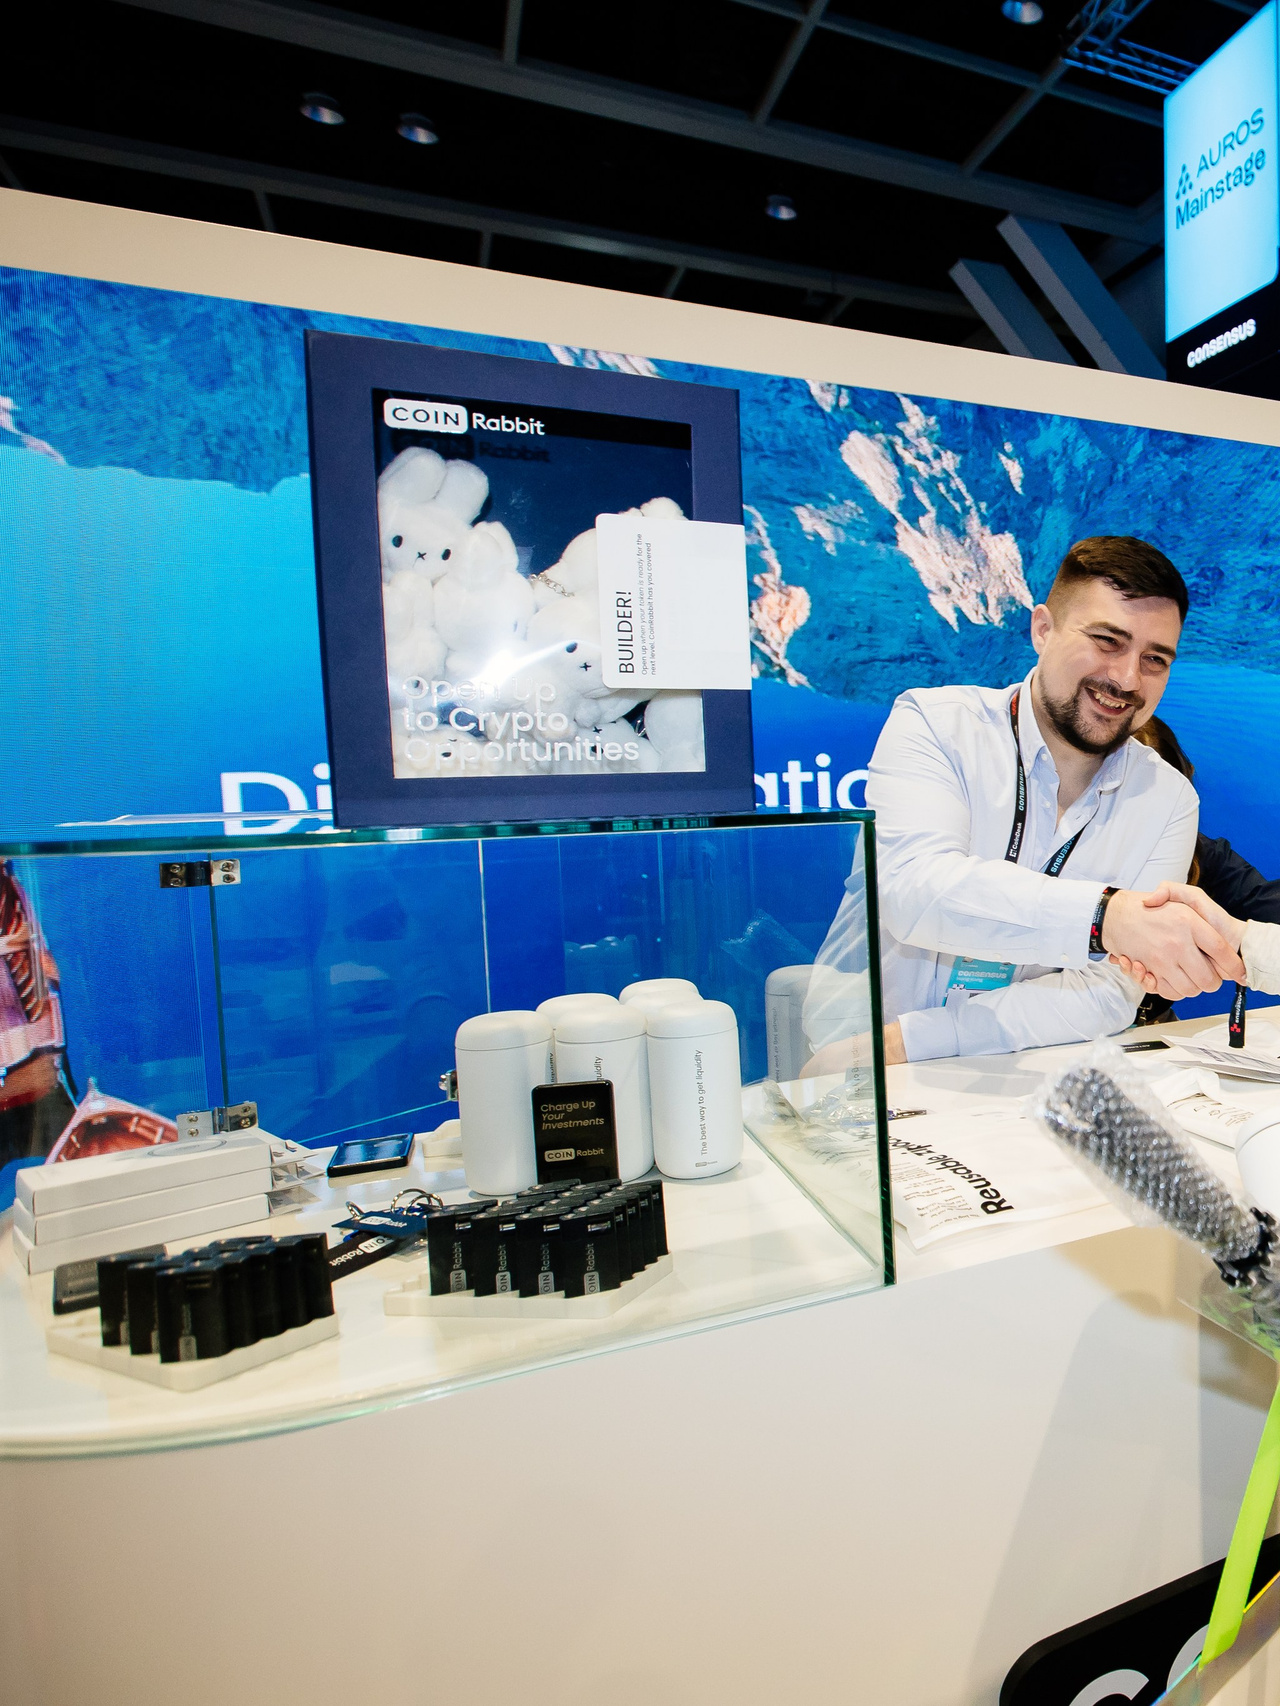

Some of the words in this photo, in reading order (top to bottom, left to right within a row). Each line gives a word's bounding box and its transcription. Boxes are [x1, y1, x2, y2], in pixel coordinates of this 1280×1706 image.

[1196, 107, 1265, 178] AUROS
[1175, 148, 1266, 229] Mainstage
[392, 406, 461, 426] COIN
[472, 412, 546, 436] Rabbit
[636, 556, 645, 578] ready
[645, 542, 653, 571] covered
[646, 572, 654, 586] you
[639, 608, 647, 624] your
[647, 601, 655, 640] CoinRabbit
[615, 590, 635, 674] BUILDER!
[641, 646, 648, 655] up
[402, 676, 500, 706] Open
[511, 676, 557, 708] Up
[402, 706, 438, 732] to
[449, 707, 569, 740] Crypto
[404, 735, 640, 770] Opportunities
[1012, 822, 1022, 850] CoinDesk
[694, 1049, 705, 1080] liquidity
[696, 1082, 706, 1095] get
[698, 1095, 705, 1105] to
[540, 1101, 580, 1113] Charge
[581, 1100, 597, 1111] Up
[541, 1112, 565, 1121] Your
[699, 1106, 707, 1122] way
[541, 1117, 605, 1130] Investments
[699, 1123, 708, 1141] best
[547, 1150, 574, 1160] COIN
[576, 1147, 605, 1158] Rabbit
[700, 1142, 708, 1156] The
[926, 1154, 1015, 1215] Reusable
[329, 1248, 364, 1266] Rabbit
[453, 1241, 462, 1270] Rabbit
[498, 1243, 507, 1272] Rabbit
[541, 1243, 550, 1272] Rabbit
[586, 1243, 595, 1272] Rabbit
